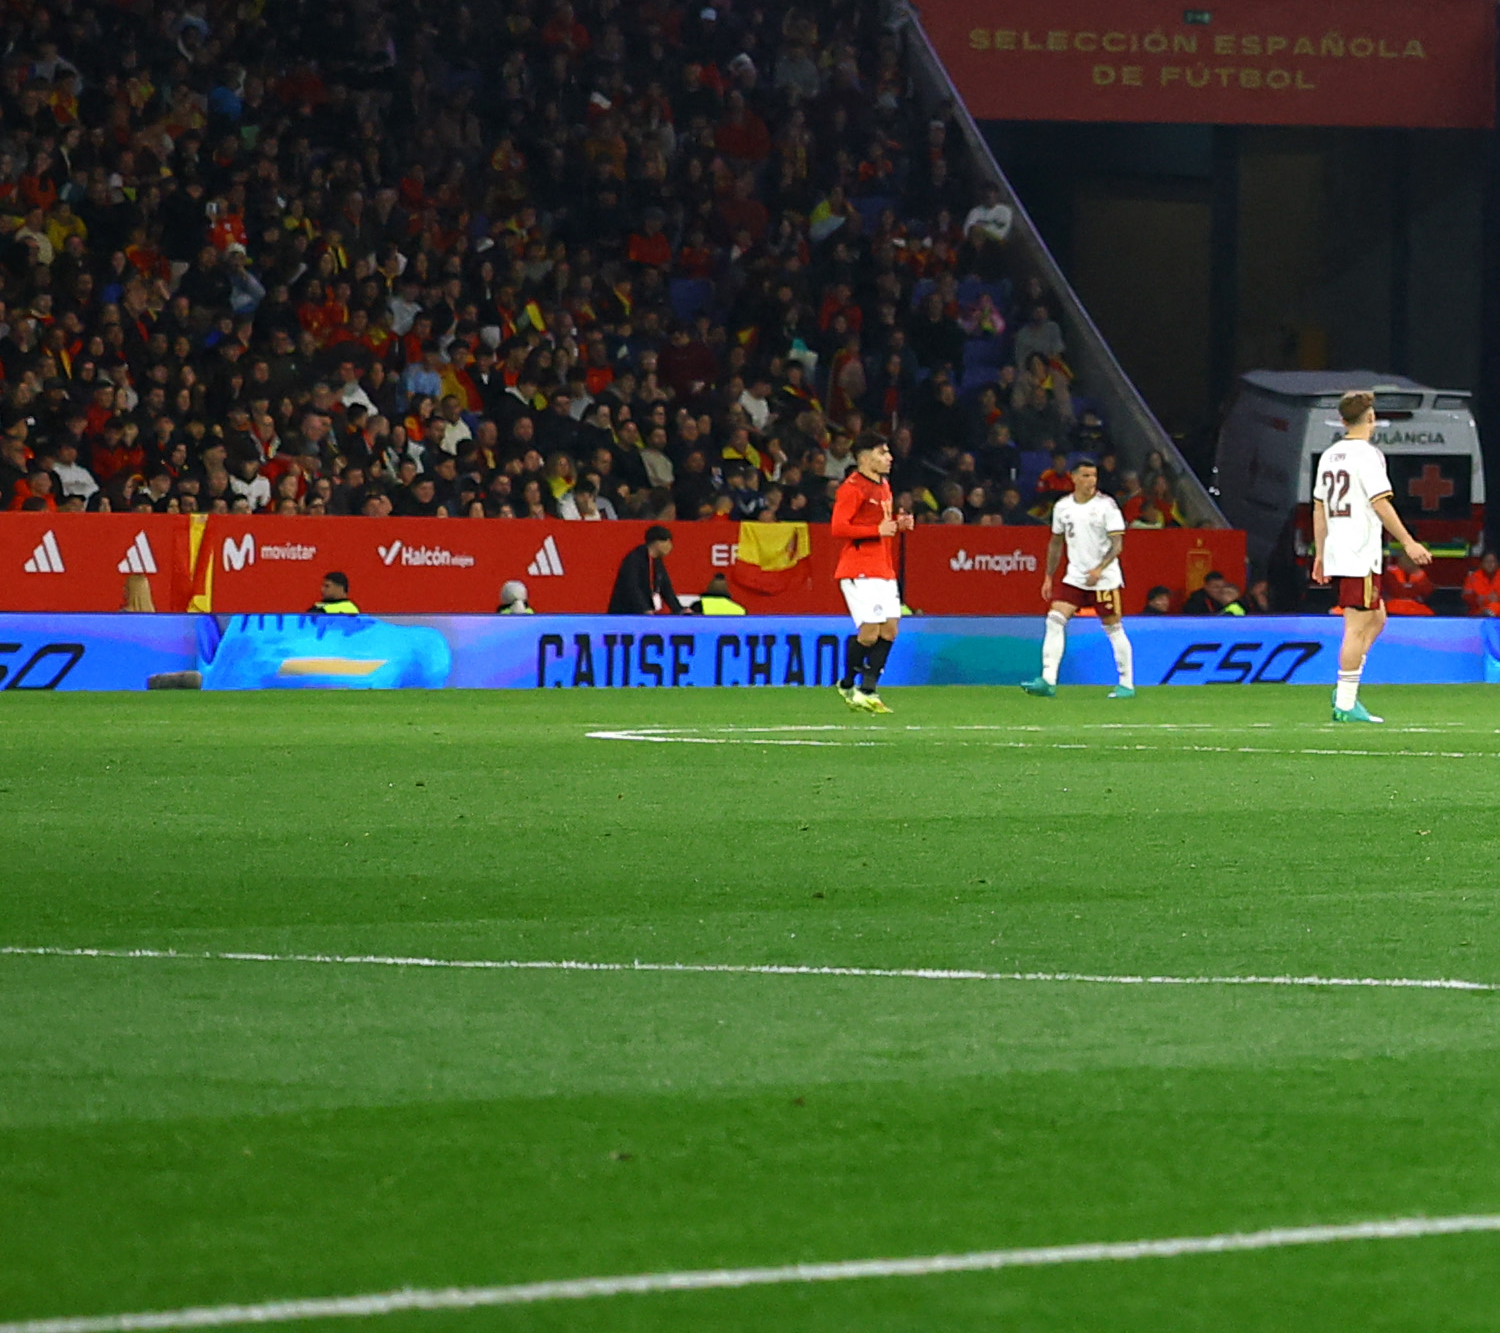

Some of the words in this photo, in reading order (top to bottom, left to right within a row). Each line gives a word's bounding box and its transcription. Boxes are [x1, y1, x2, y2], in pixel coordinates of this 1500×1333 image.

[969, 26, 1199, 56] SELECCIÓN
[1213, 30, 1426, 60] ESPAÑOLA
[1092, 64, 1143, 87] DE
[1321, 469, 1352, 518] 22
[260, 542, 316, 561] movistar
[402, 545, 450, 567] Halcón
[974, 549, 1037, 576] mapfre
[538, 634, 695, 687] CAUSE
